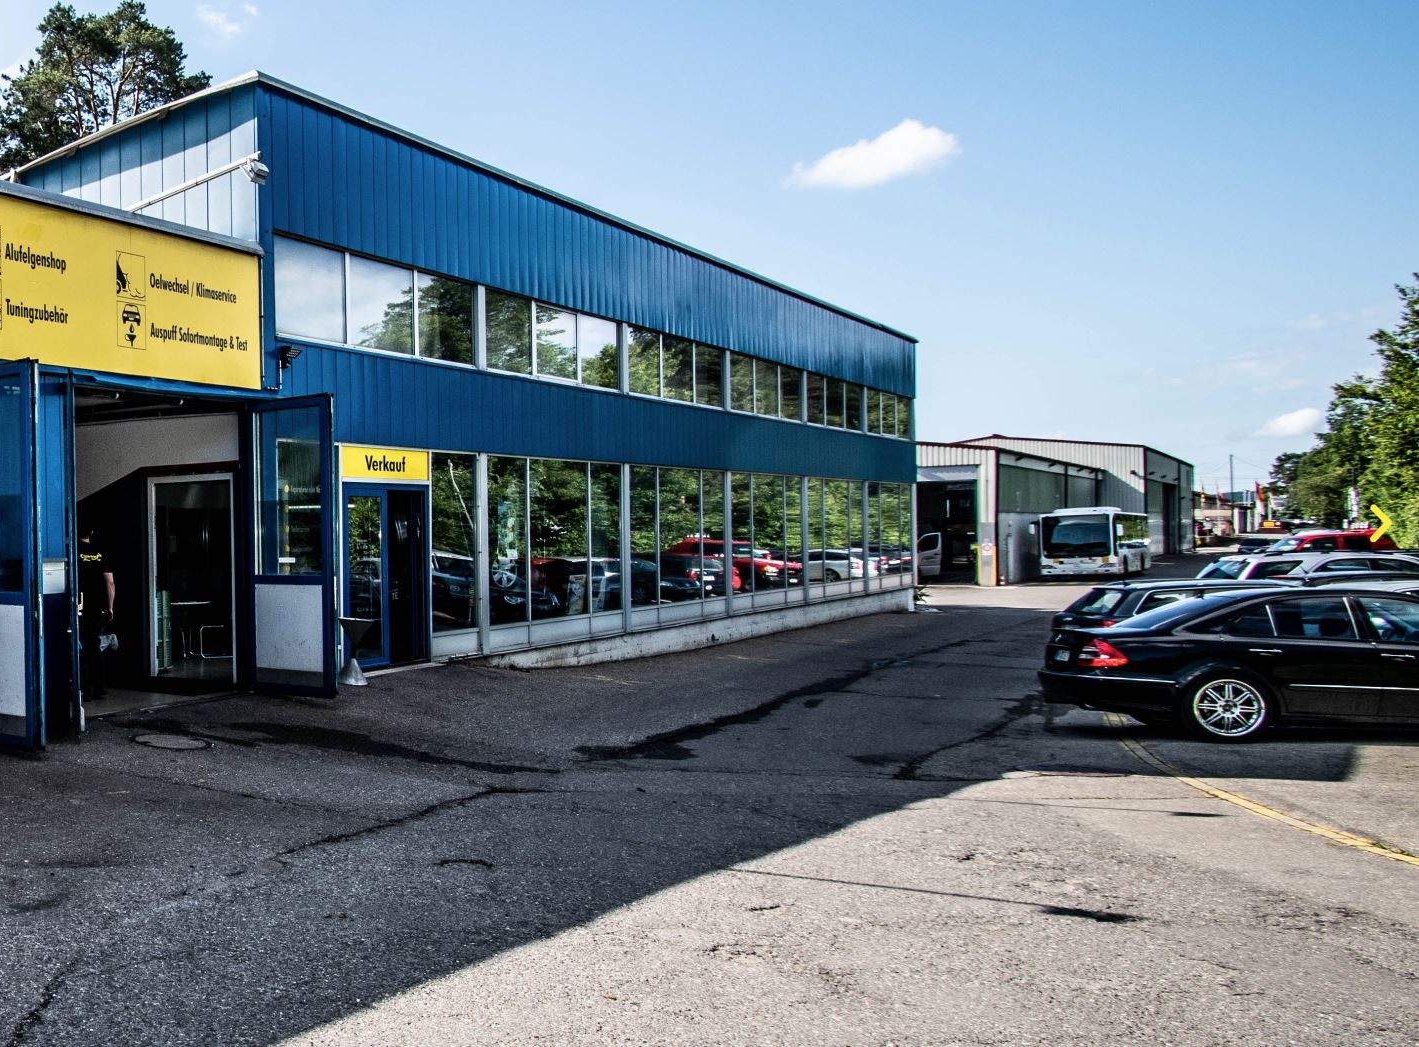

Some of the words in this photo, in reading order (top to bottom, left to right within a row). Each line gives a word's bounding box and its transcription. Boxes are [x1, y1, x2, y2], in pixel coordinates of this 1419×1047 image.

[5, 243, 66, 274] Alufelgenshop
[150, 273, 189, 294] Oelwechsel
[196, 283, 236, 303] Klimaservice
[6, 299, 68, 323] Tuningzubehör
[151, 323, 177, 342] Auspuff
[179, 328, 227, 351] Sofortmontage
[229, 336, 235, 350] &
[236, 337, 247, 351] Test
[365, 455, 406, 473] Verkauf
